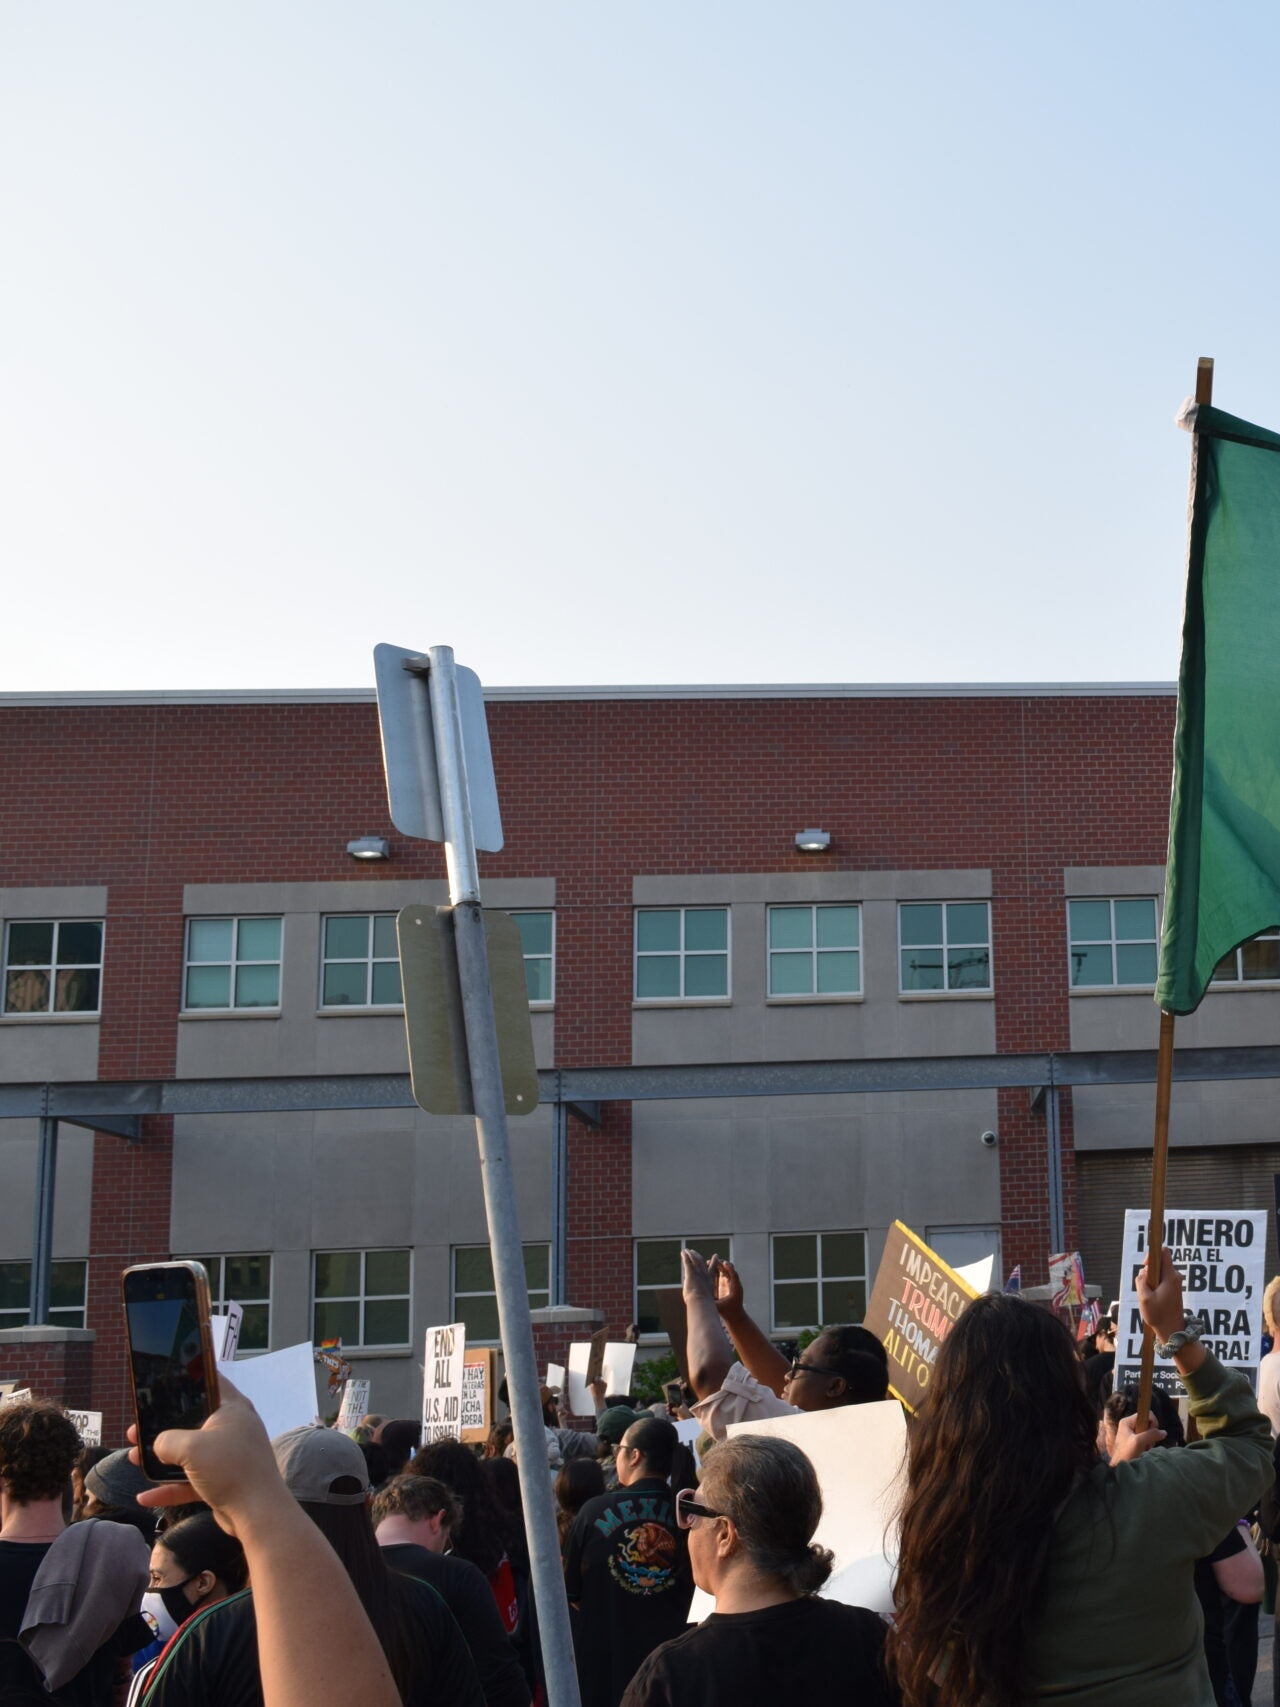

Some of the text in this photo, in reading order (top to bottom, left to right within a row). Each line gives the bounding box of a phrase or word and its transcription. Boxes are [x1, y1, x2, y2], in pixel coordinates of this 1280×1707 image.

[1206, 1249, 1224, 1262] EL
[434, 1327, 456, 1358] END
[889, 1297, 940, 1366] THOMA
[882, 1328, 930, 1388] ALITO
[433, 1359, 452, 1389] ALL
[467, 1368, 484, 1380] HAY
[469, 1389, 476, 1398] LA
[425, 1396, 459, 1423] U.S. AID
[461, 1401, 481, 1413] UCHA
[424, 1425, 432, 1444] TO
